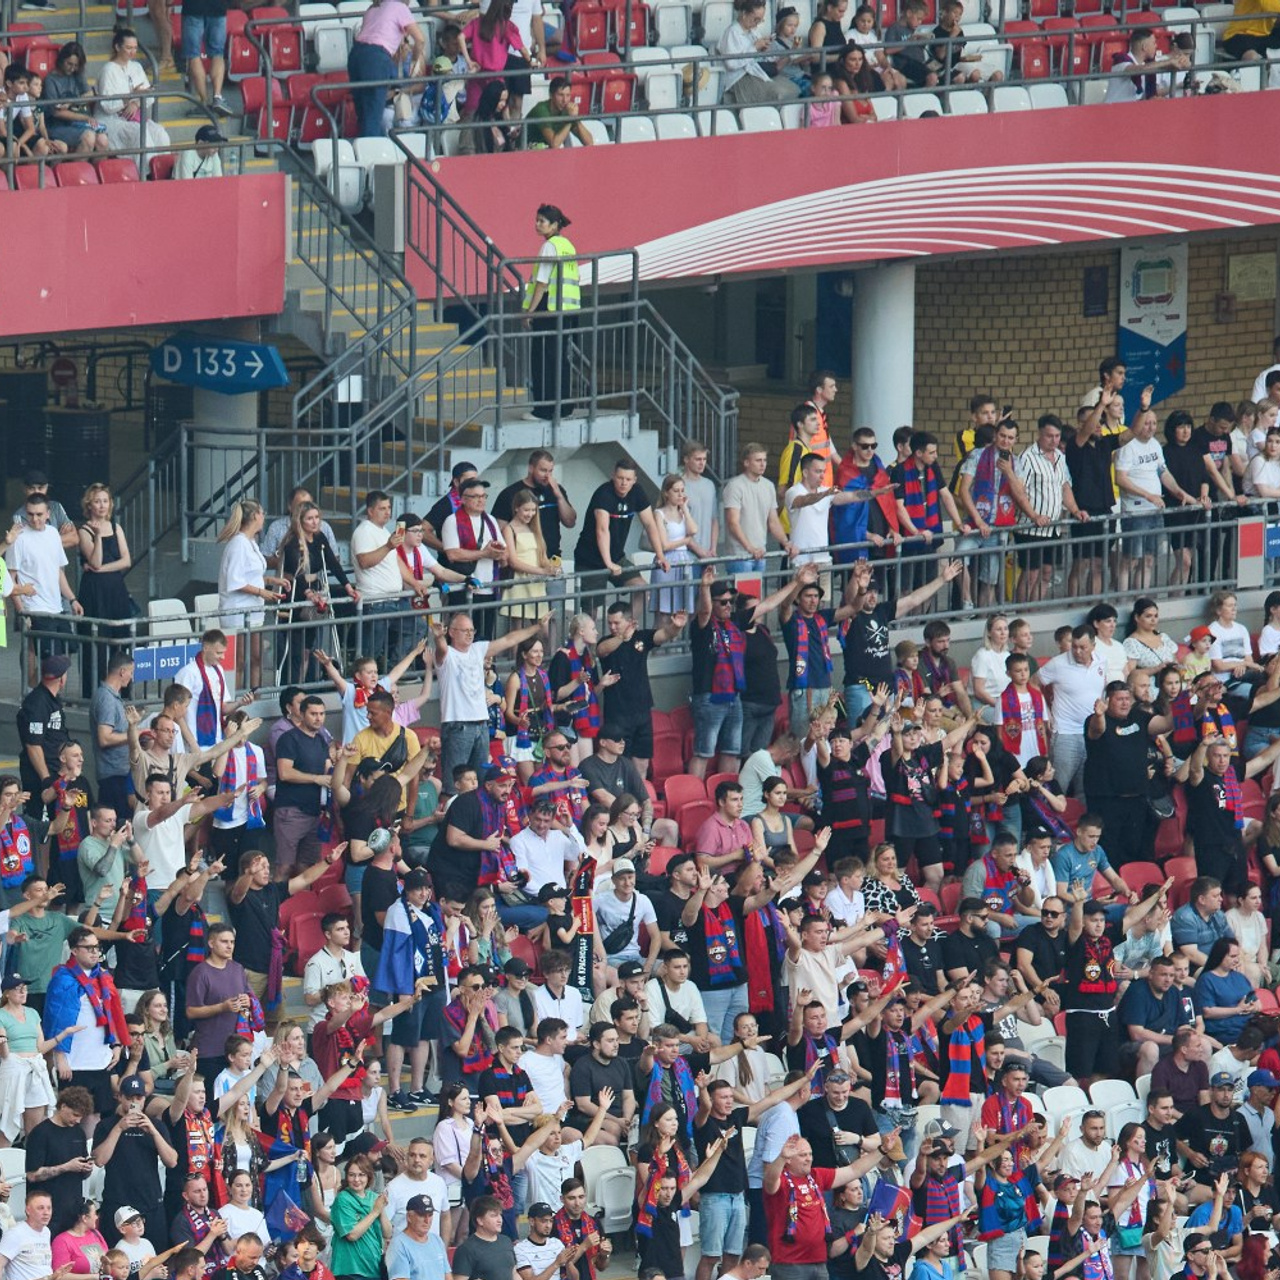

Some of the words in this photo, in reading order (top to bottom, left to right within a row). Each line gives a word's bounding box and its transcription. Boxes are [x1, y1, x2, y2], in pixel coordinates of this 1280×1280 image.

[163, 346, 181, 372] D
[194, 347, 236, 377] 133
[160, 657, 180, 668] D133
